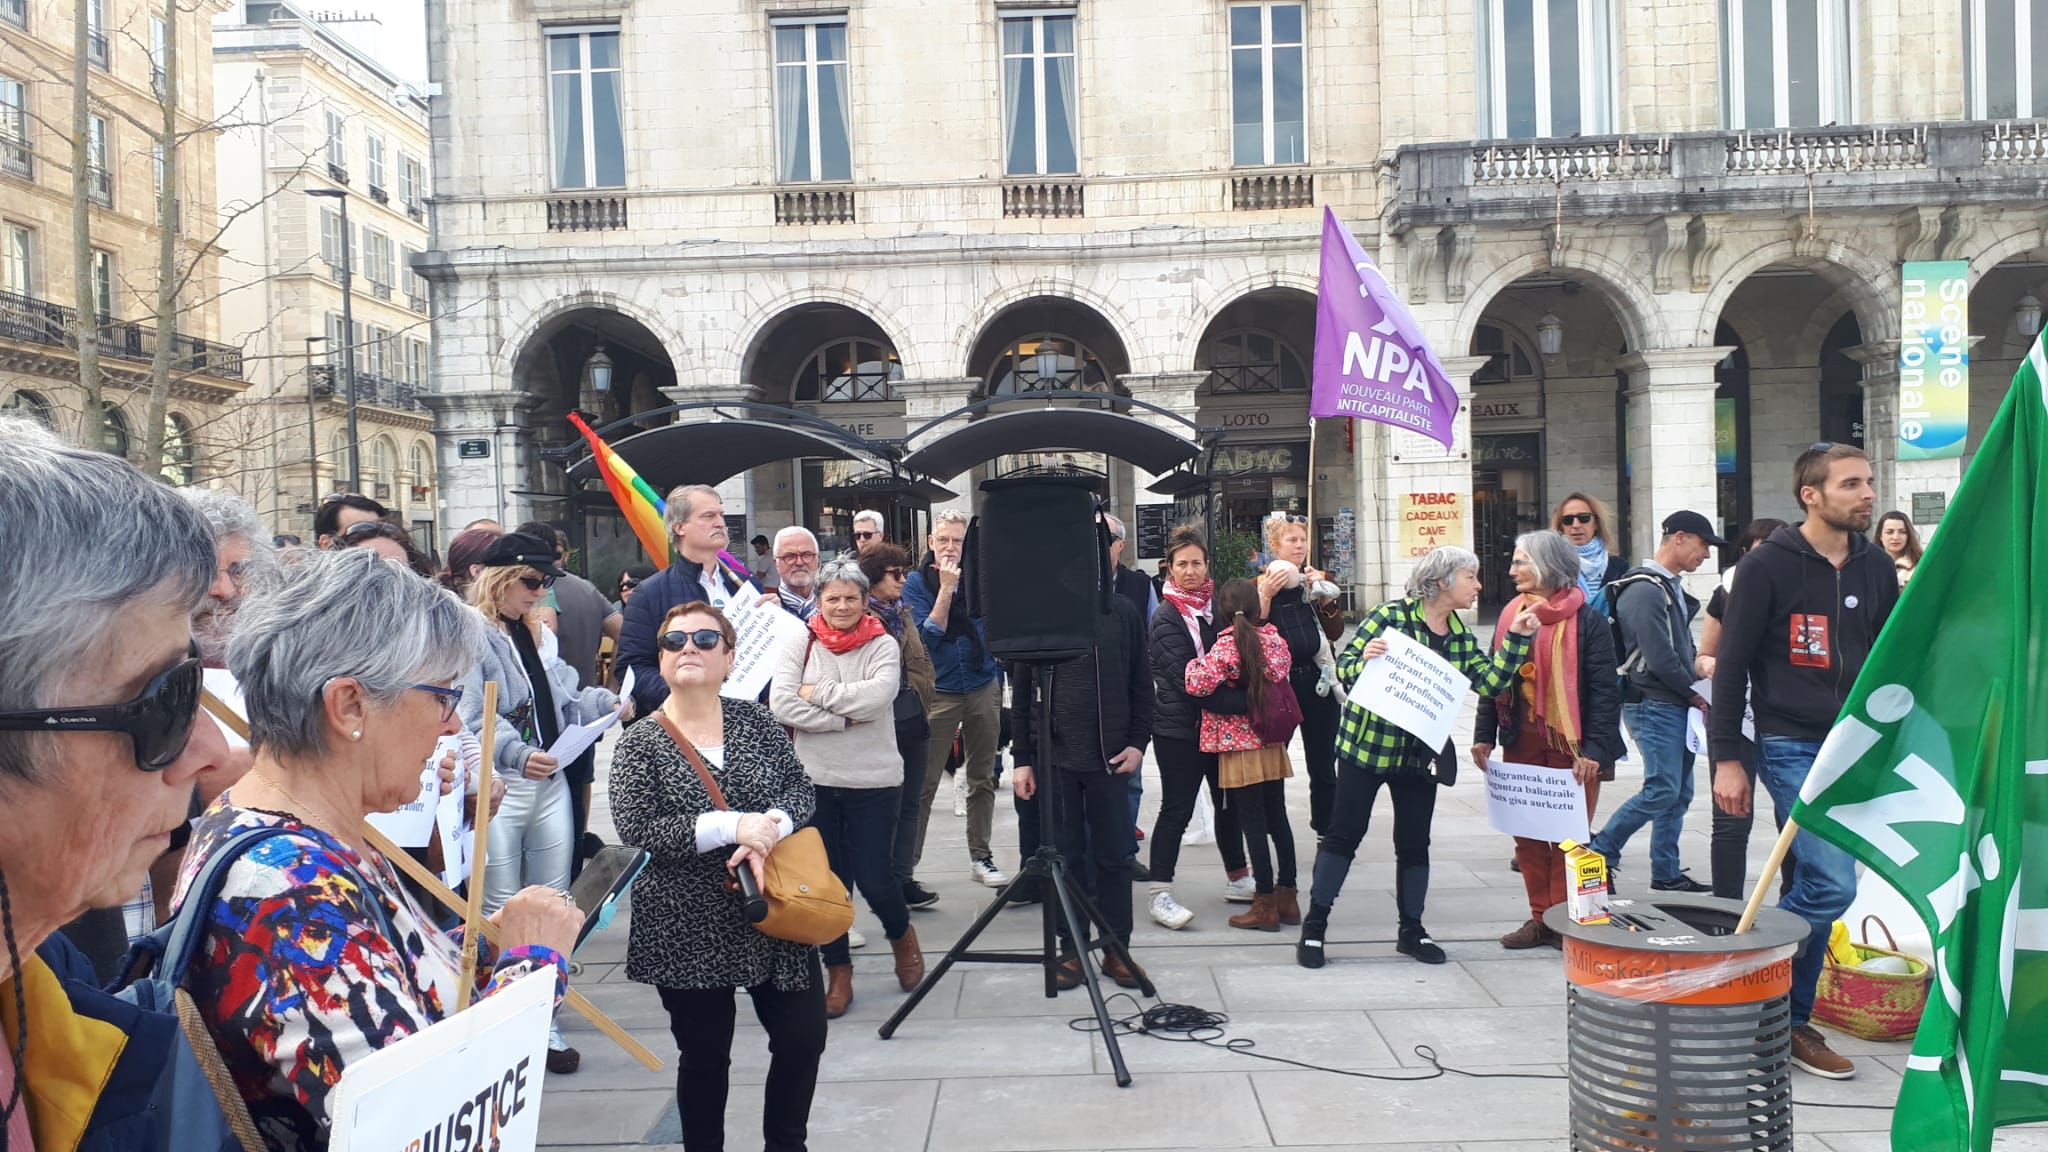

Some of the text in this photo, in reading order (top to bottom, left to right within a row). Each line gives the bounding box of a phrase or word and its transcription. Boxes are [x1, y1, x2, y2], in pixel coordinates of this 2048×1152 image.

[1900, 279, 1933, 441] nationale
[1342, 331, 1434, 404] NPA
[1340, 383, 1431, 417] NOUVEAU PARTI
[1336, 398, 1433, 432] ANTICAPITALISTE
[1471, 403, 1520, 416] EAUX
[1222, 413, 1269, 427] LOTO
[1213, 447, 1292, 473] ABAC
[1409, 492, 1456, 505] TABAC
[1406, 510, 1459, 521] CADEAUX
[1418, 526, 1447, 536] CAVE
[1428, 536, 1436, 545] A
[1410, 546, 1434, 557] CIG
[744, 660, 756, 674] lieu
[1404, 647, 1453, 685] Présenter les
[1384, 654, 1456, 704] migrant.es comme
[1388, 671, 1444, 711] des profiteurs
[1489, 768, 1567, 786] Migranteak diru
[1525, 785, 1576, 799] baliatzaile
[1508, 796, 1527, 806] gisa
[1530, 800, 1574, 811] aurkeztu
[1583, 866, 1600, 875] UHU
